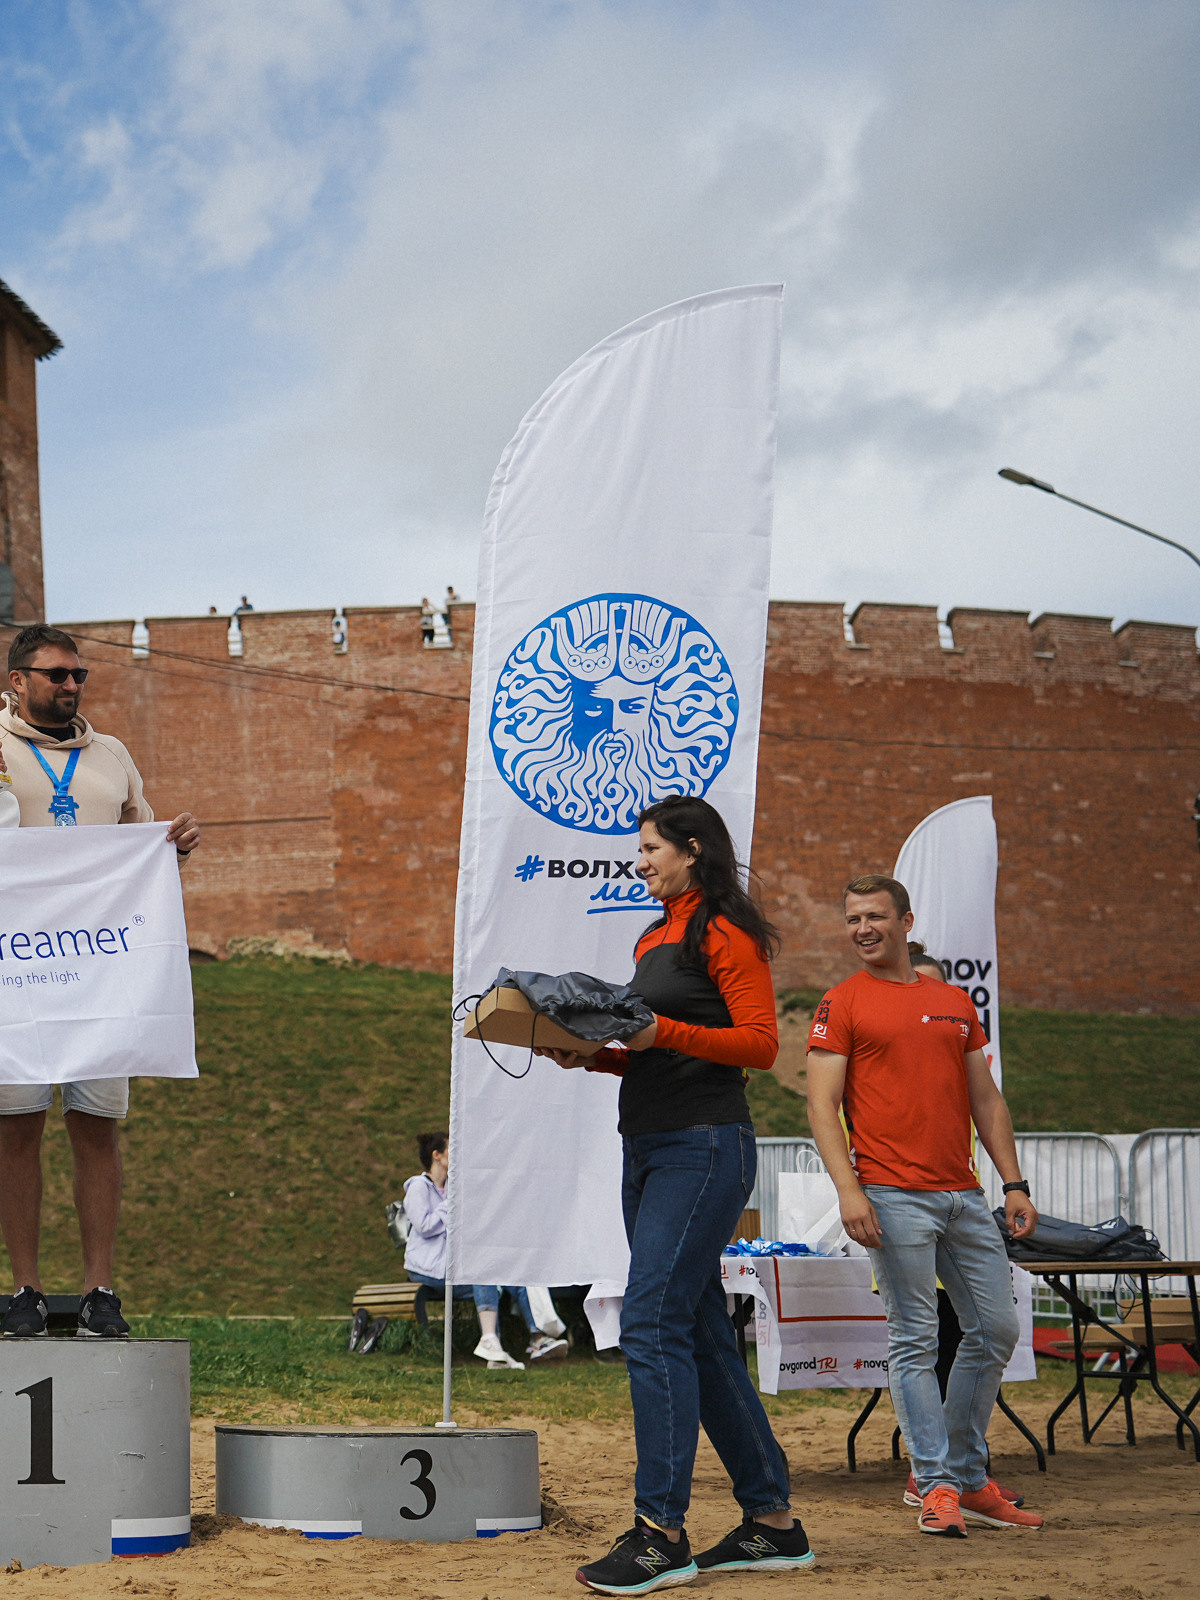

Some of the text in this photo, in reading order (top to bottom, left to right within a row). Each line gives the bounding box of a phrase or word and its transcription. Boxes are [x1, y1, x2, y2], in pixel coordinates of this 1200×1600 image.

[590, 882, 658, 904] ме
[26, 972, 48, 985] the
[50, 970, 81, 985] light
[14, 1376, 66, 1485] 1
[399, 1448, 437, 1520] 3
